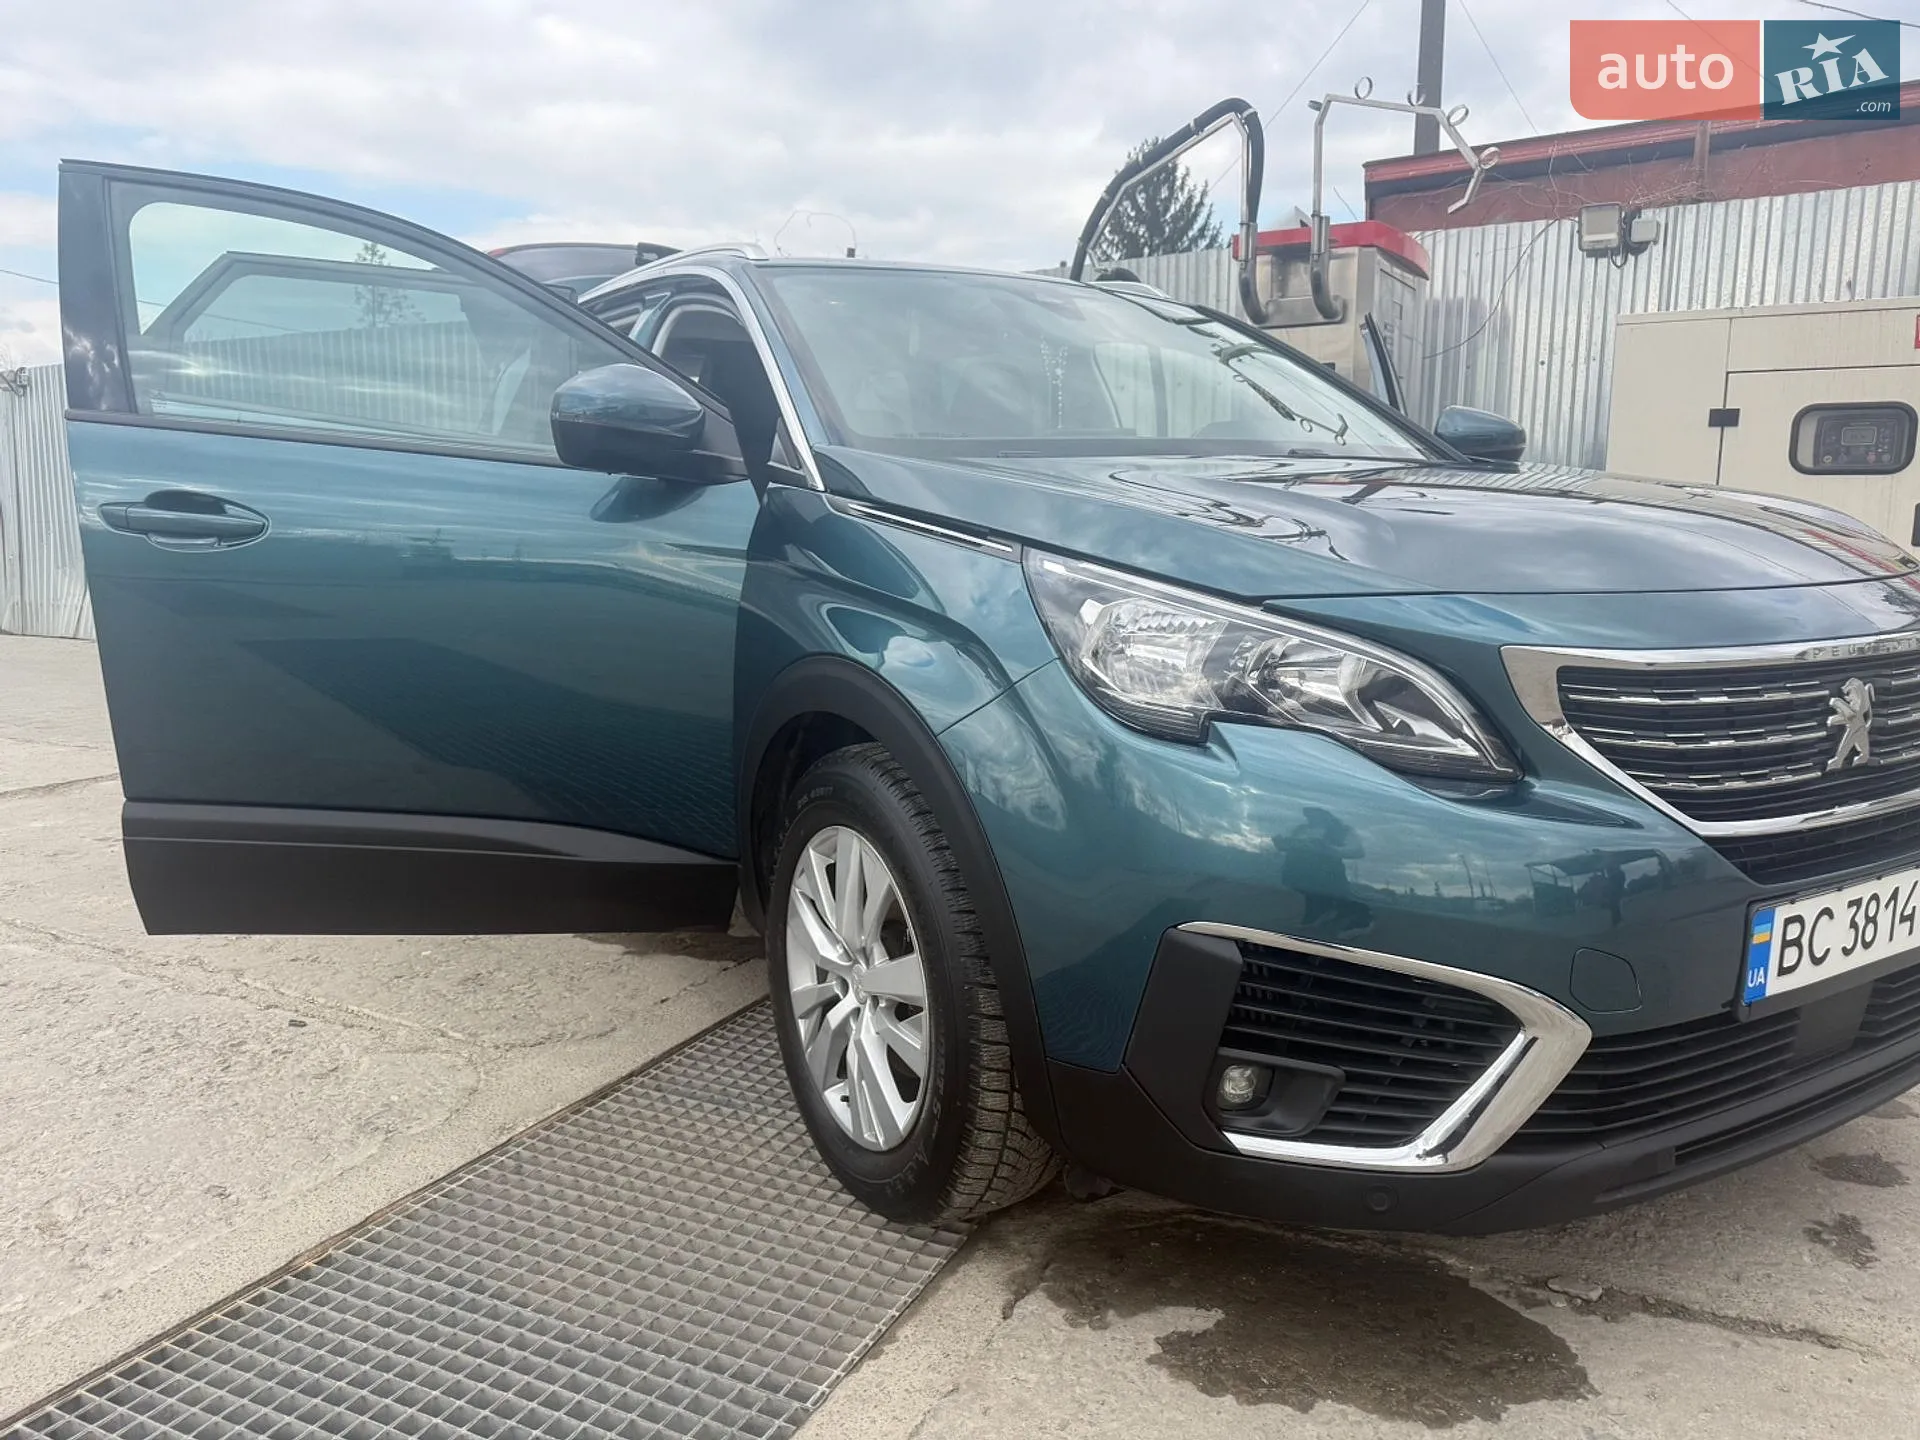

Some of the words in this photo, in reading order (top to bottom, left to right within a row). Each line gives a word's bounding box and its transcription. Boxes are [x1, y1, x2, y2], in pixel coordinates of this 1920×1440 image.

[1777, 906, 1835, 977] BC
[1841, 880, 1919, 957] 3814
[1747, 966, 1766, 988] UA
